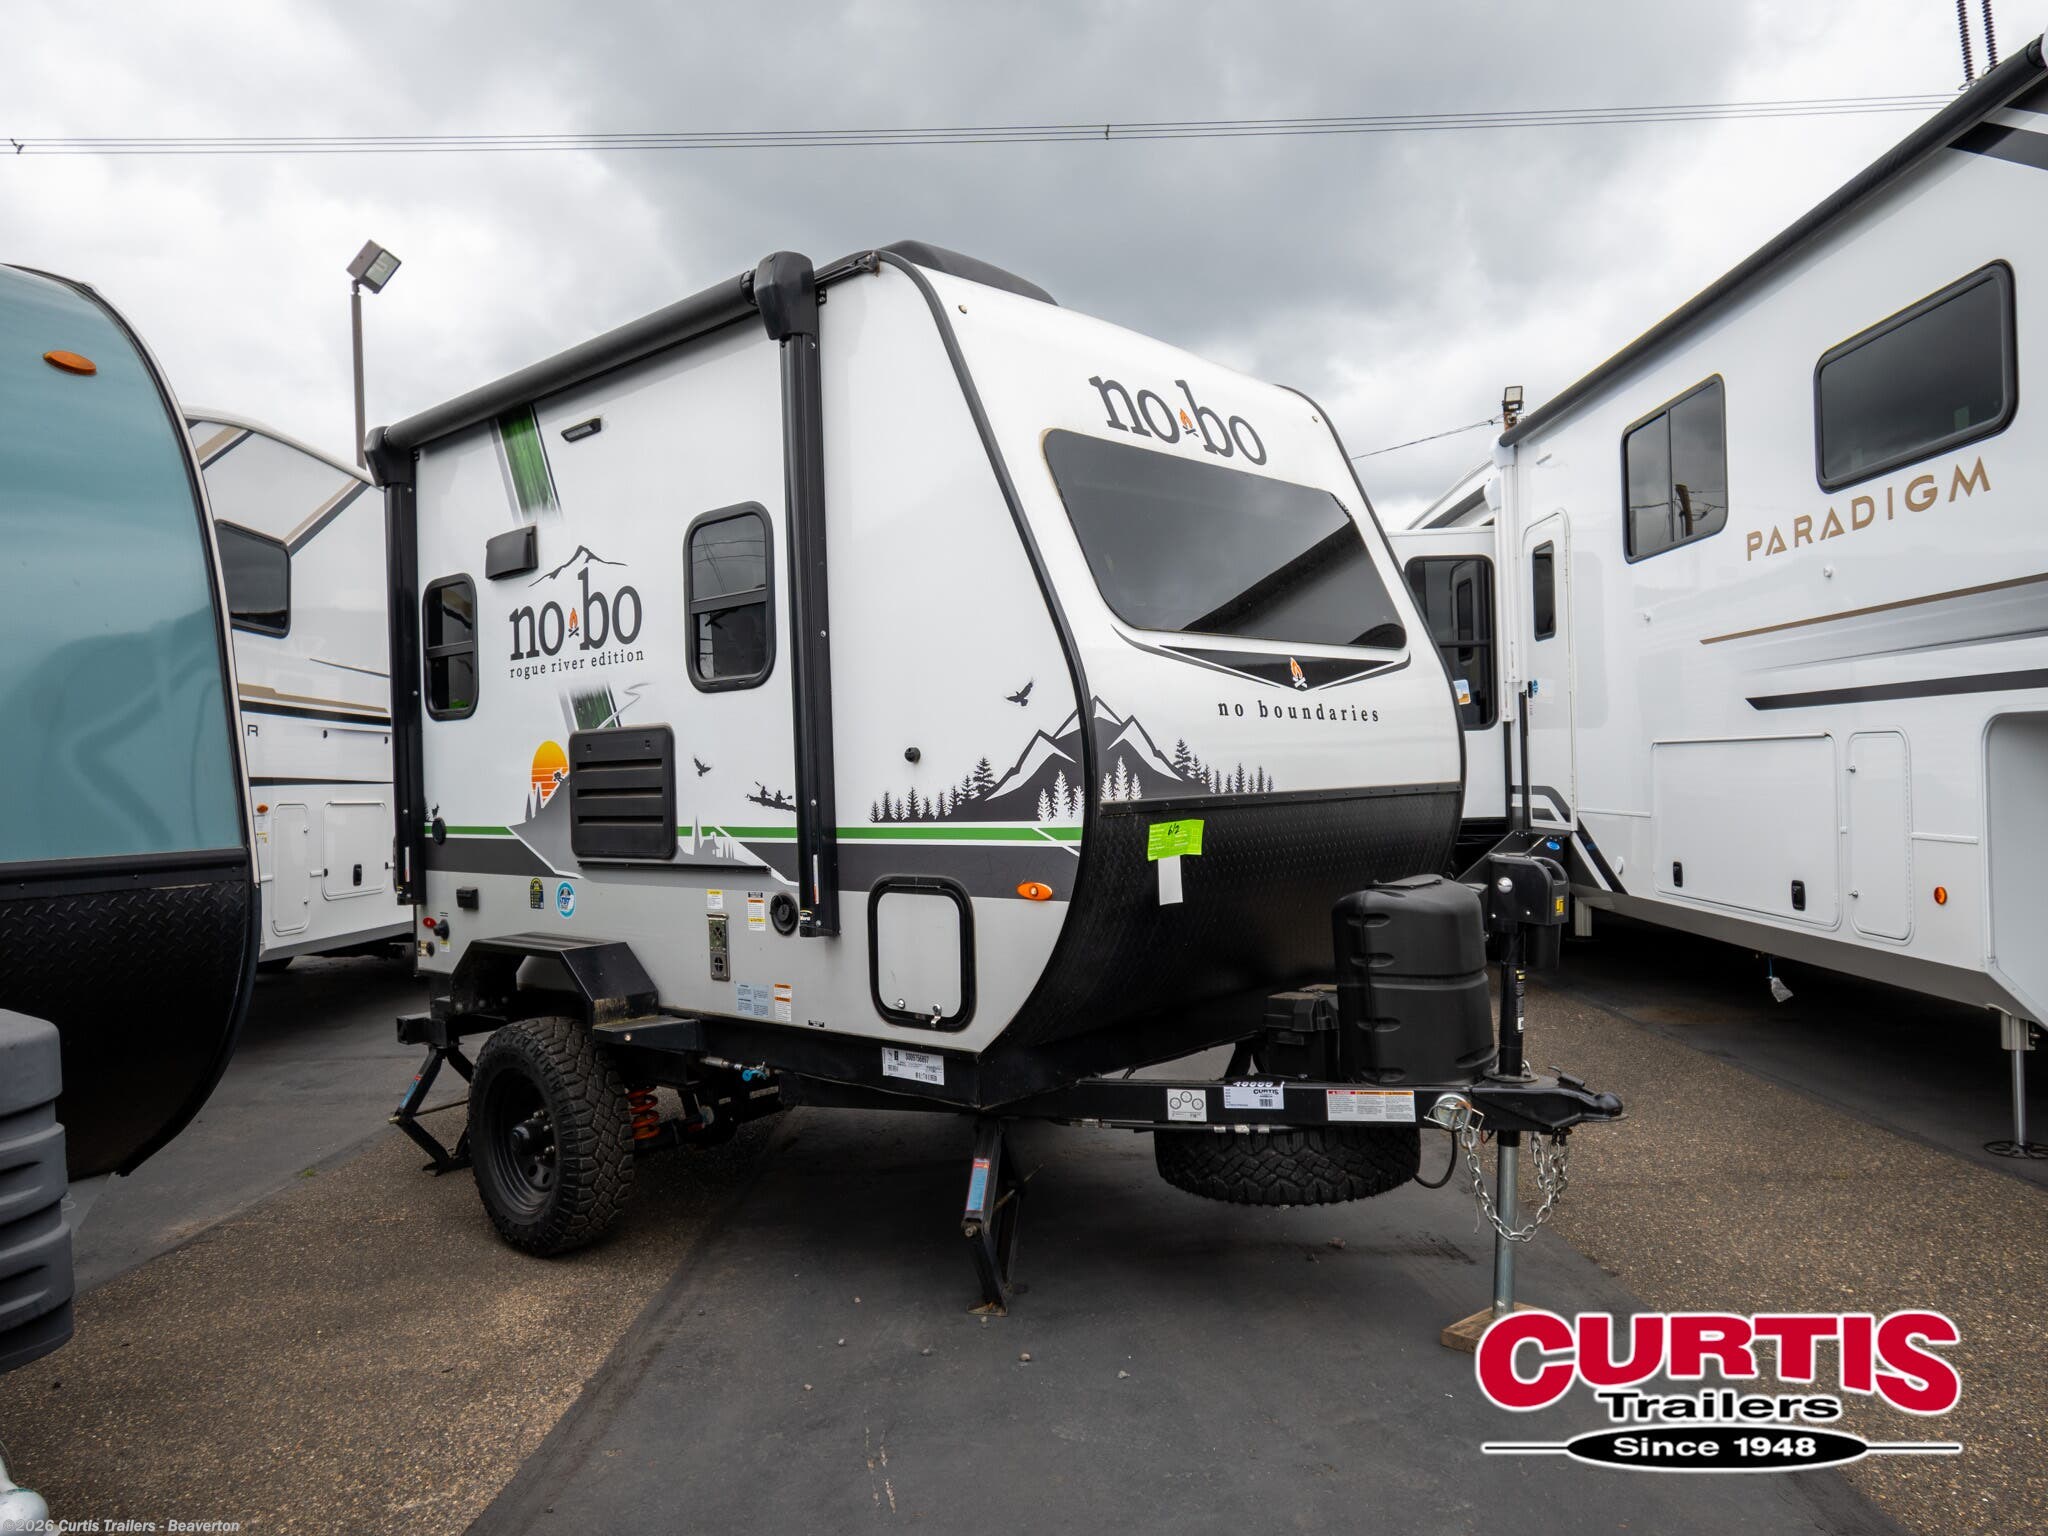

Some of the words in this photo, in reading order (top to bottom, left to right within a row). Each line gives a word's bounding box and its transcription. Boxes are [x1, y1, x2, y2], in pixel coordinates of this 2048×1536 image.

[1746, 455, 1991, 561] PARADIGM
[510, 667, 546, 680] rogue
[551, 658, 585, 673] river
[591, 649, 644, 667] edition
[1217, 702, 1244, 717] no
[1257, 700, 1379, 722] boundaries
